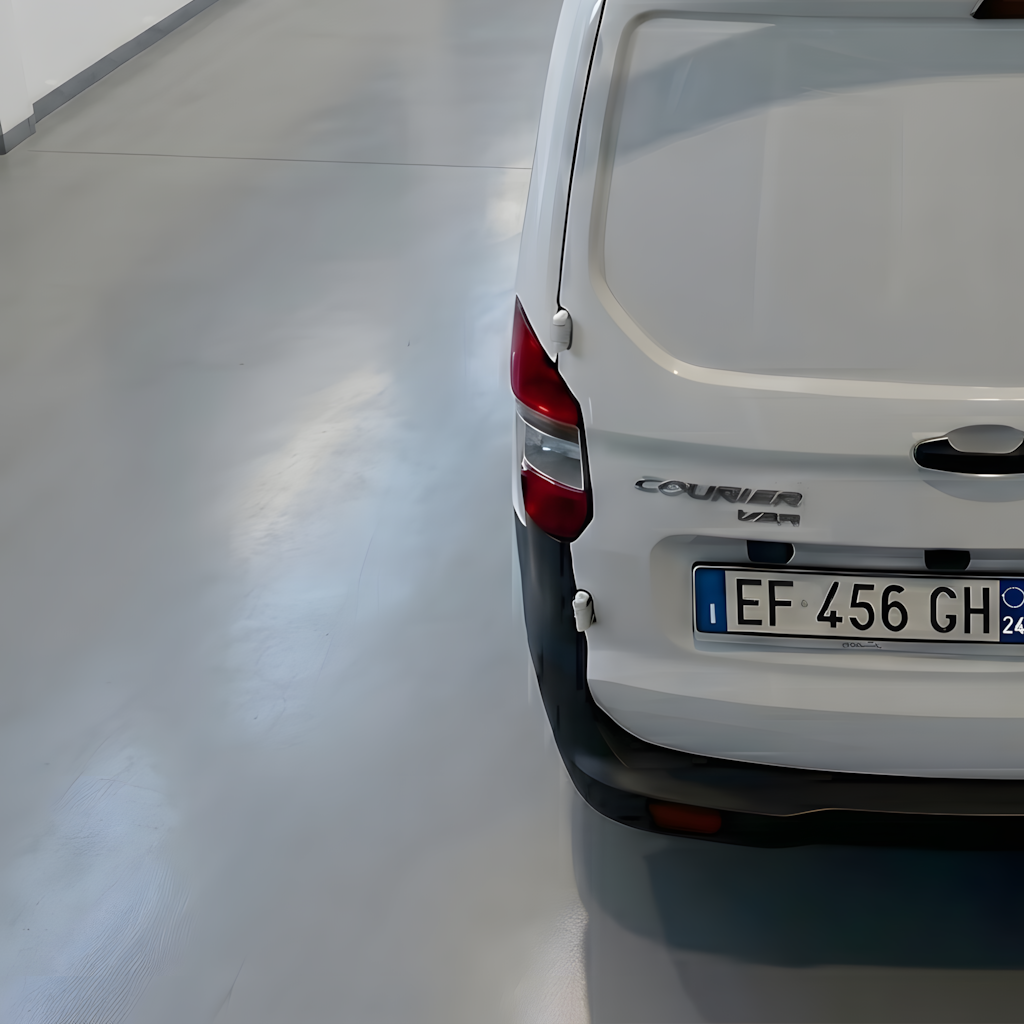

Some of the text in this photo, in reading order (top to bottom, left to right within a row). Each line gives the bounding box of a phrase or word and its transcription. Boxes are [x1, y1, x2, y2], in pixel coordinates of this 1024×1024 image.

[736, 578, 990, 634] EF 456 GH
